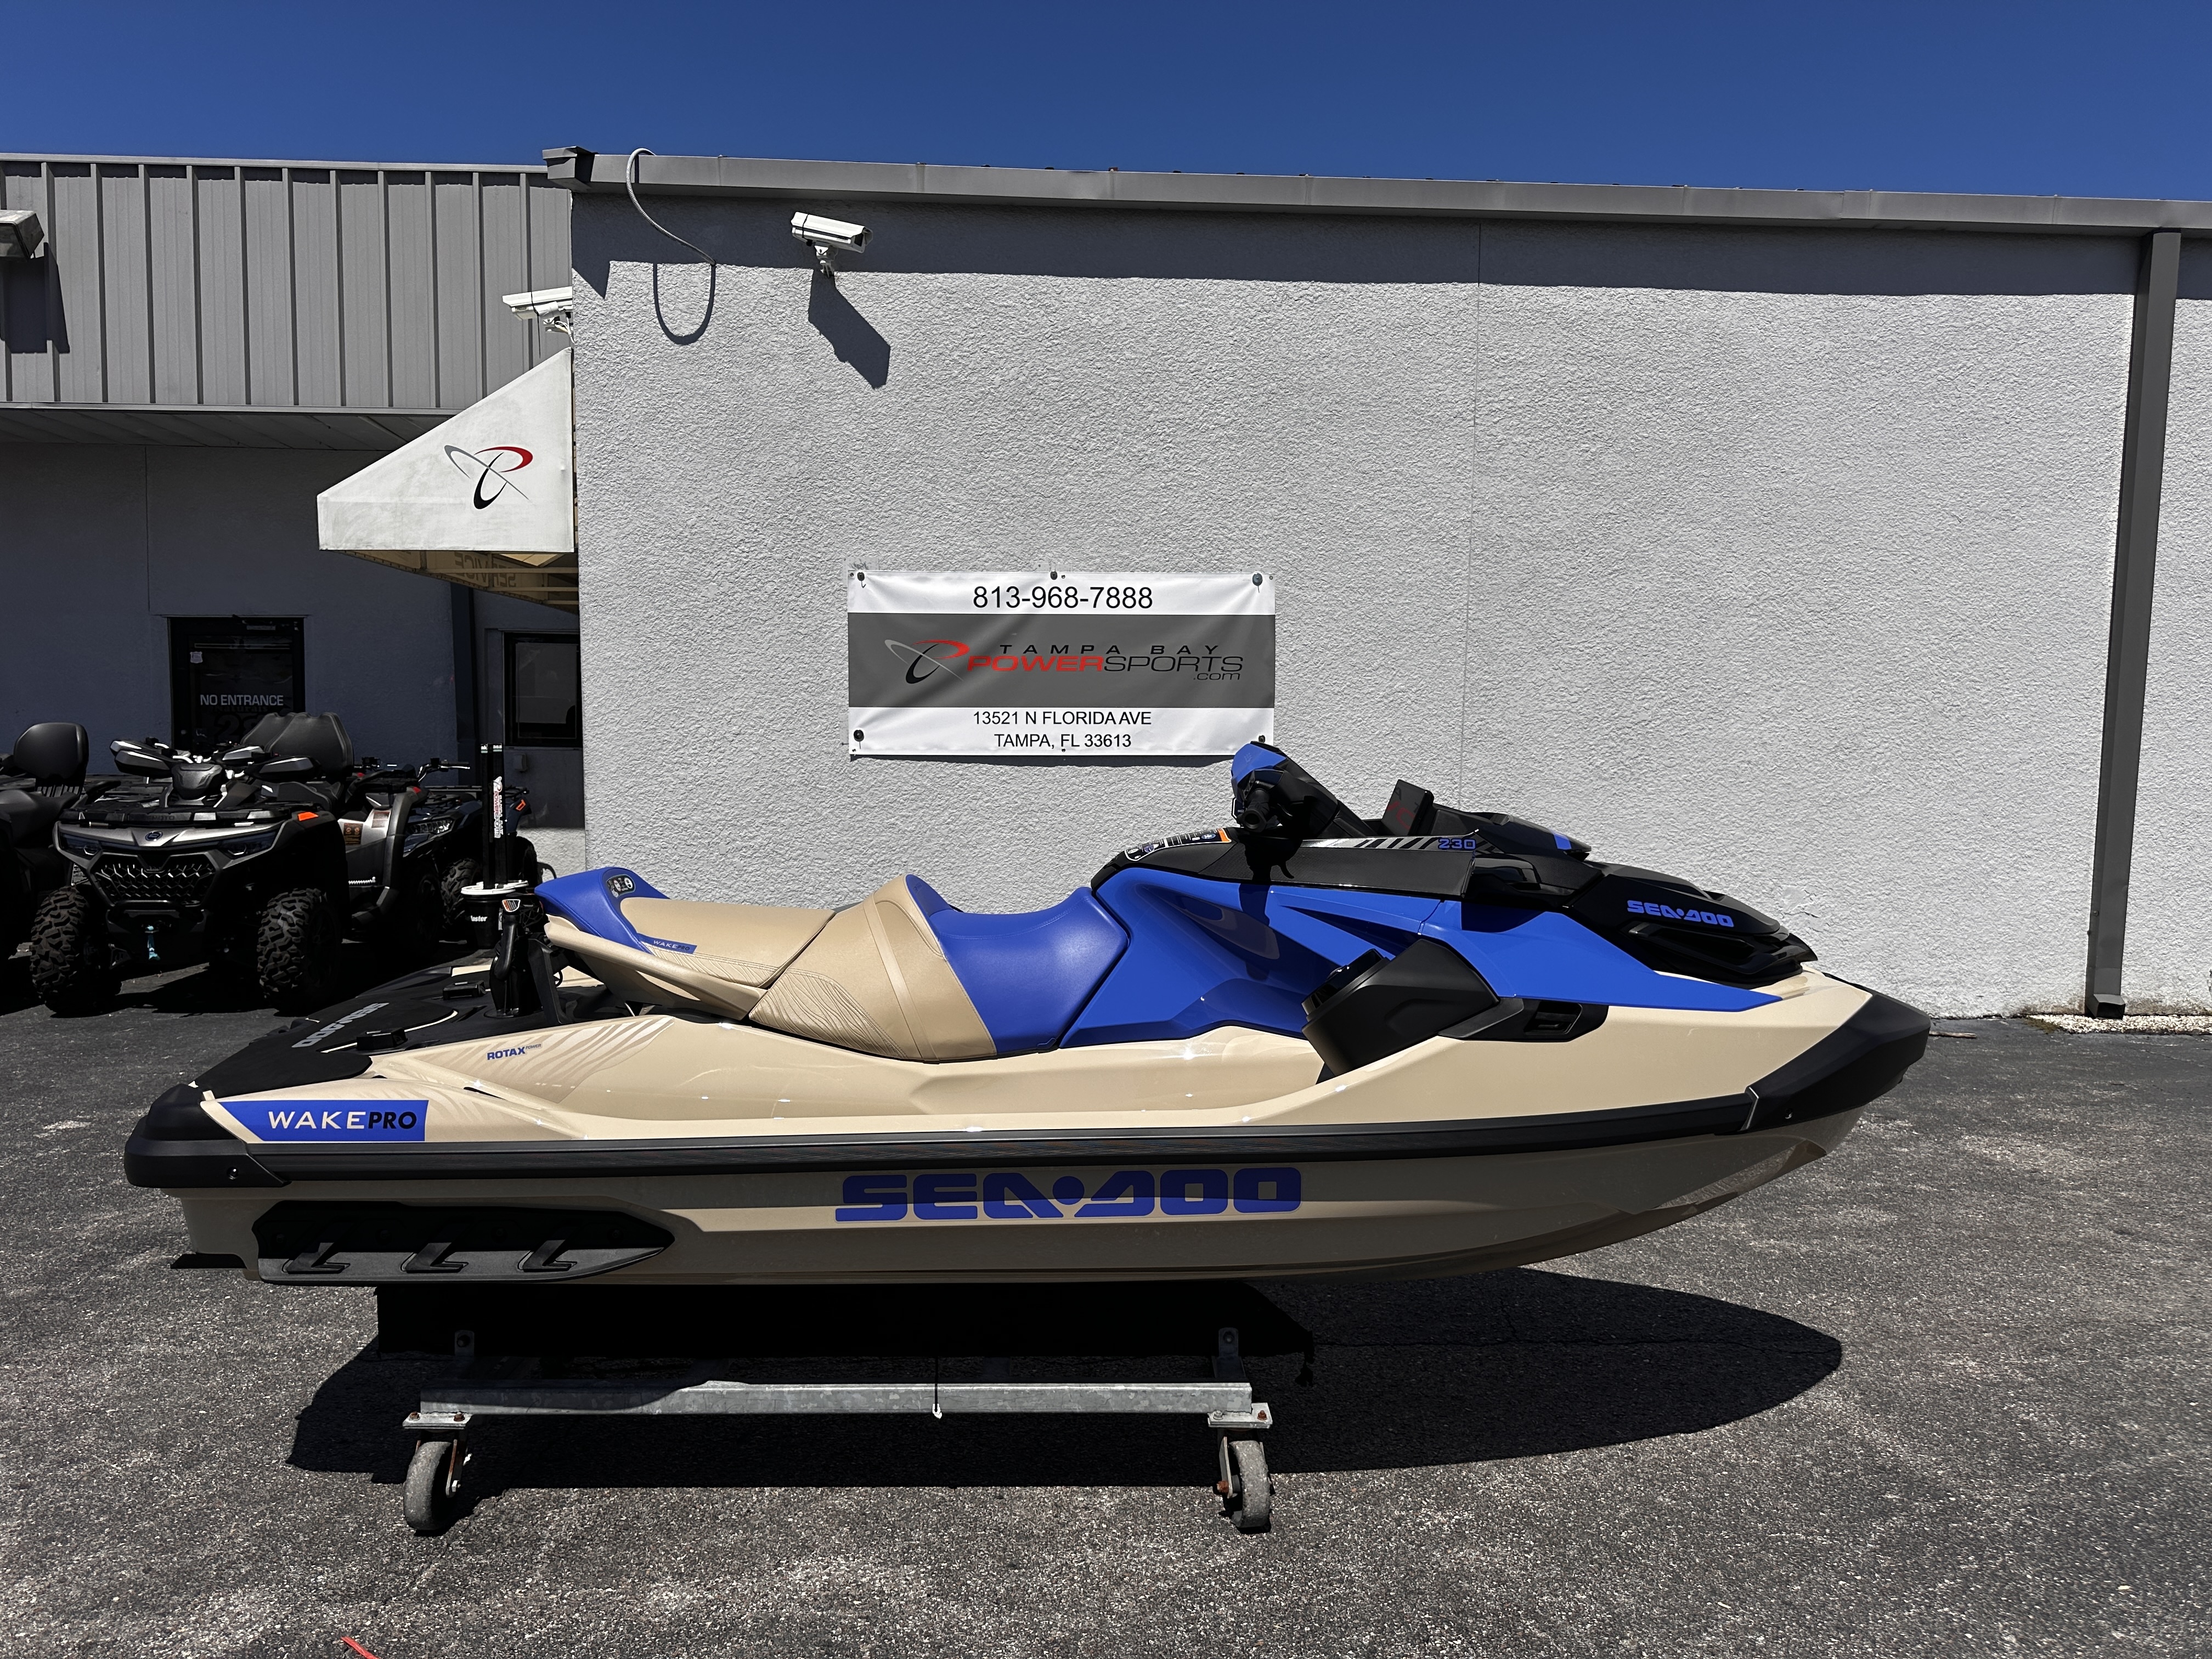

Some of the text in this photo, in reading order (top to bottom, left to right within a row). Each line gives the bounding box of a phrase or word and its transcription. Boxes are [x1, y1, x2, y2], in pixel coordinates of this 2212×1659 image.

[973, 586, 1153, 609] 813-968-7888
[999, 644, 1221, 654] TAMPA BAY
[967, 655, 1244, 673] POWERSPORTS
[1192, 672, 1241, 681] .com
[200, 695, 284, 706] NO ENTRANCE
[973, 712, 1152, 725] 13521 N FLORIDA AVE
[994, 733, 1132, 749] TAMPA, FL 33613
[1438, 838, 1476, 850] 230
[487, 1046, 526, 1060] ROTAX
